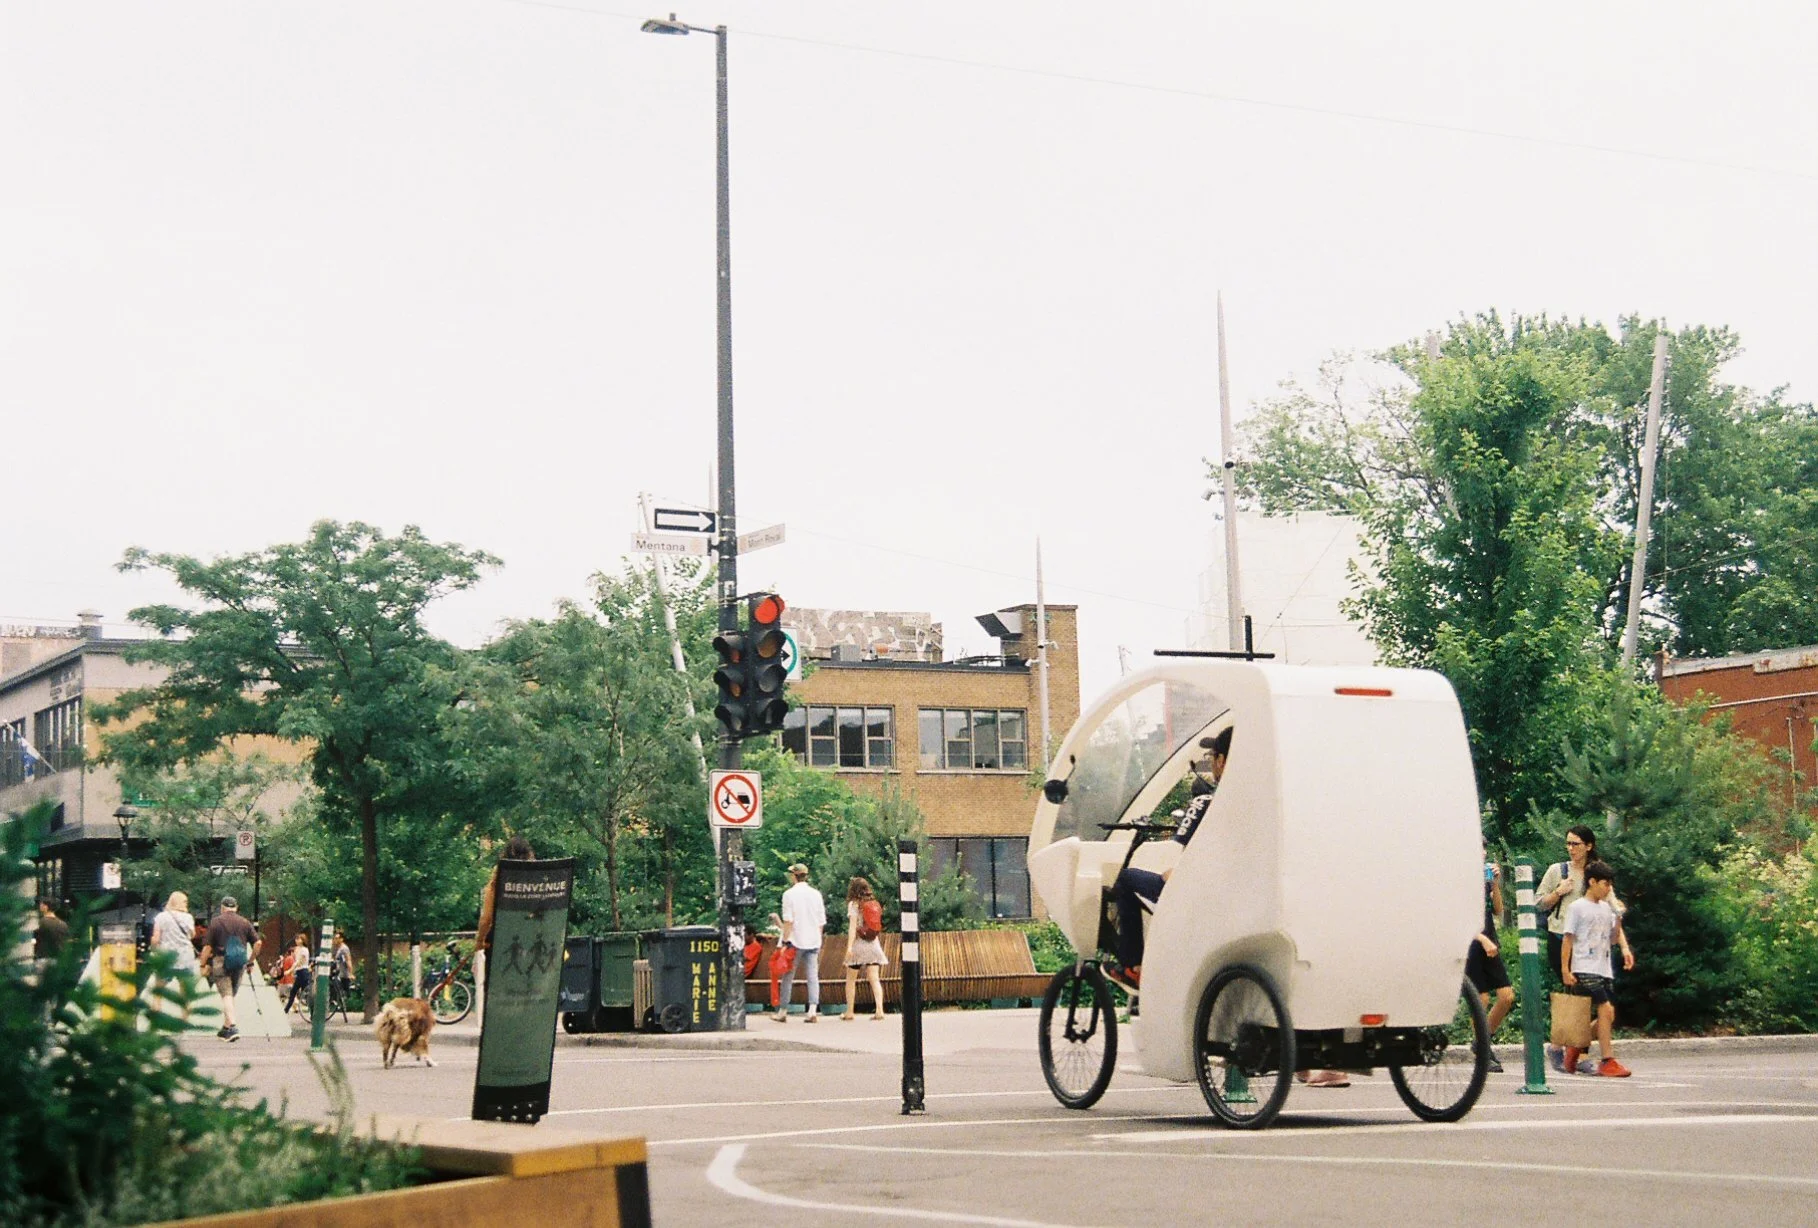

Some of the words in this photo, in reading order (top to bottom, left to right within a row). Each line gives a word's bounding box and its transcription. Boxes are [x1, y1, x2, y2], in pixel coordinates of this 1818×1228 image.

[636, 540, 686, 551] Mentana
[504, 881, 567, 892] BIENVENUE
[690, 941, 719, 953] 1150
[708, 962, 717, 1012] ANNE
[692, 963, 701, 1024] MARIE
